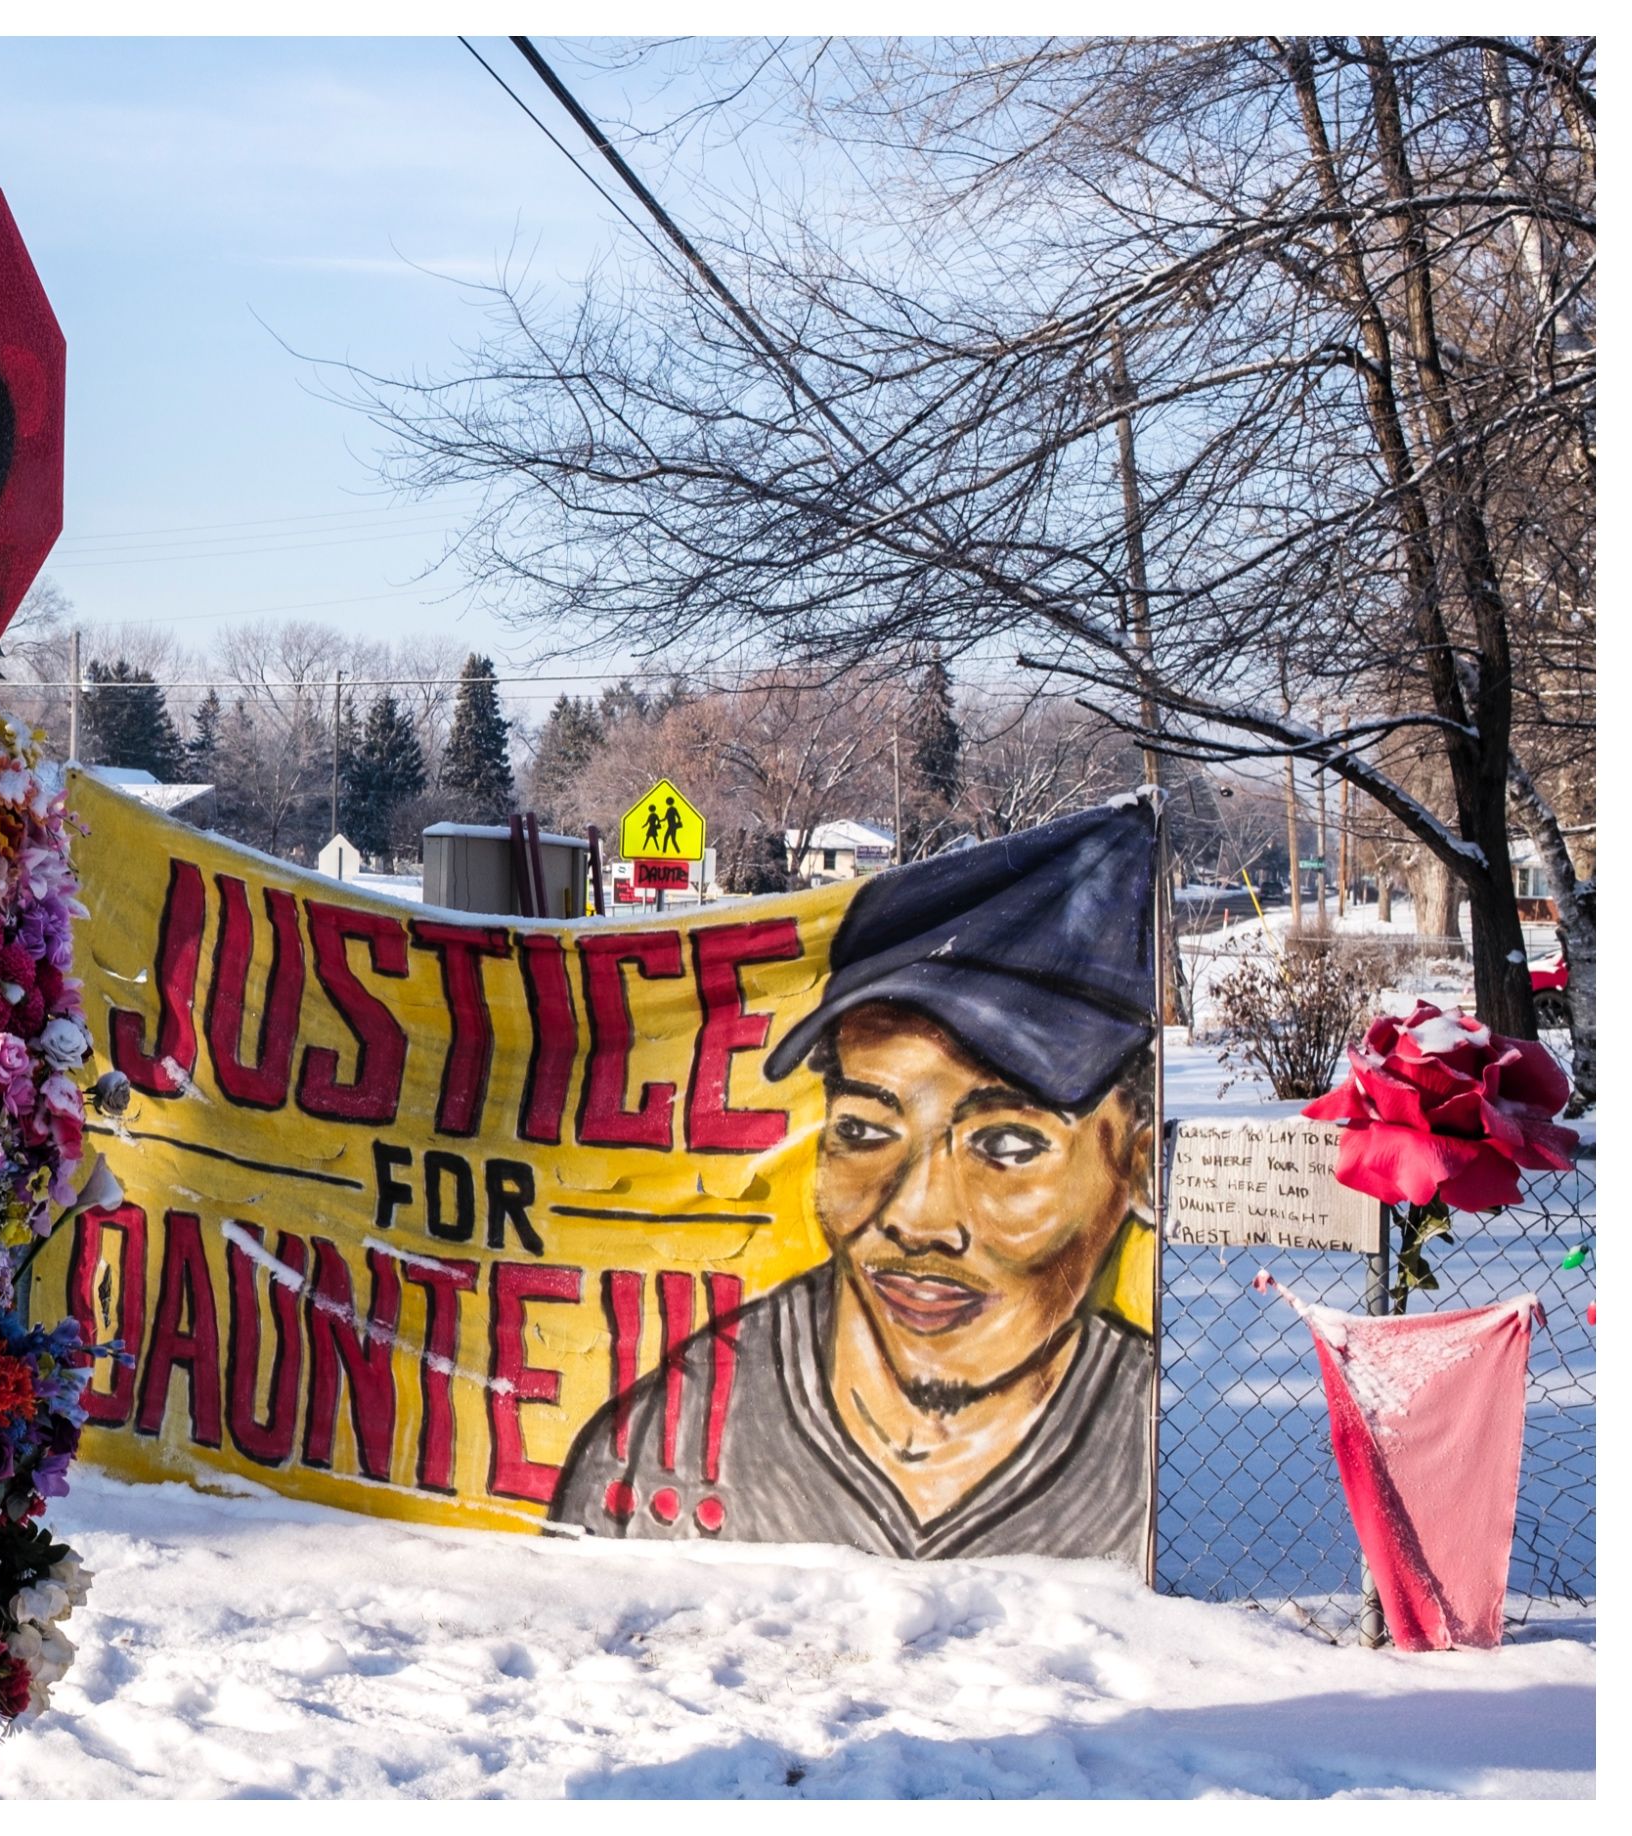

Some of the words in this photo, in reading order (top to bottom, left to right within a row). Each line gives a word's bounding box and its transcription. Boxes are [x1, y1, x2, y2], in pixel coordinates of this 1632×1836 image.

[109, 858, 806, 1154] JUSTICE
[1269, 1131, 1296, 1145] LAY
[1302, 1132, 1319, 1145] TO
[1324, 1133, 1341, 1147] RE
[1177, 1152, 1192, 1163] IS
[1201, 1155, 1252, 1167] WHERE
[1267, 1156, 1299, 1173] YOUR
[1308, 1161, 1336, 1176] SPIR
[371, 1139, 545, 1256] FOR
[1176, 1174, 1216, 1188] STAYS
[1228, 1180, 1267, 1192] HERE
[1278, 1184, 1309, 1199] LAID
[1248, 1205, 1329, 1225] WRIGHT
[1181, 1226, 1230, 1246] REST
[1278, 1231, 1353, 1252] HEAVEN
